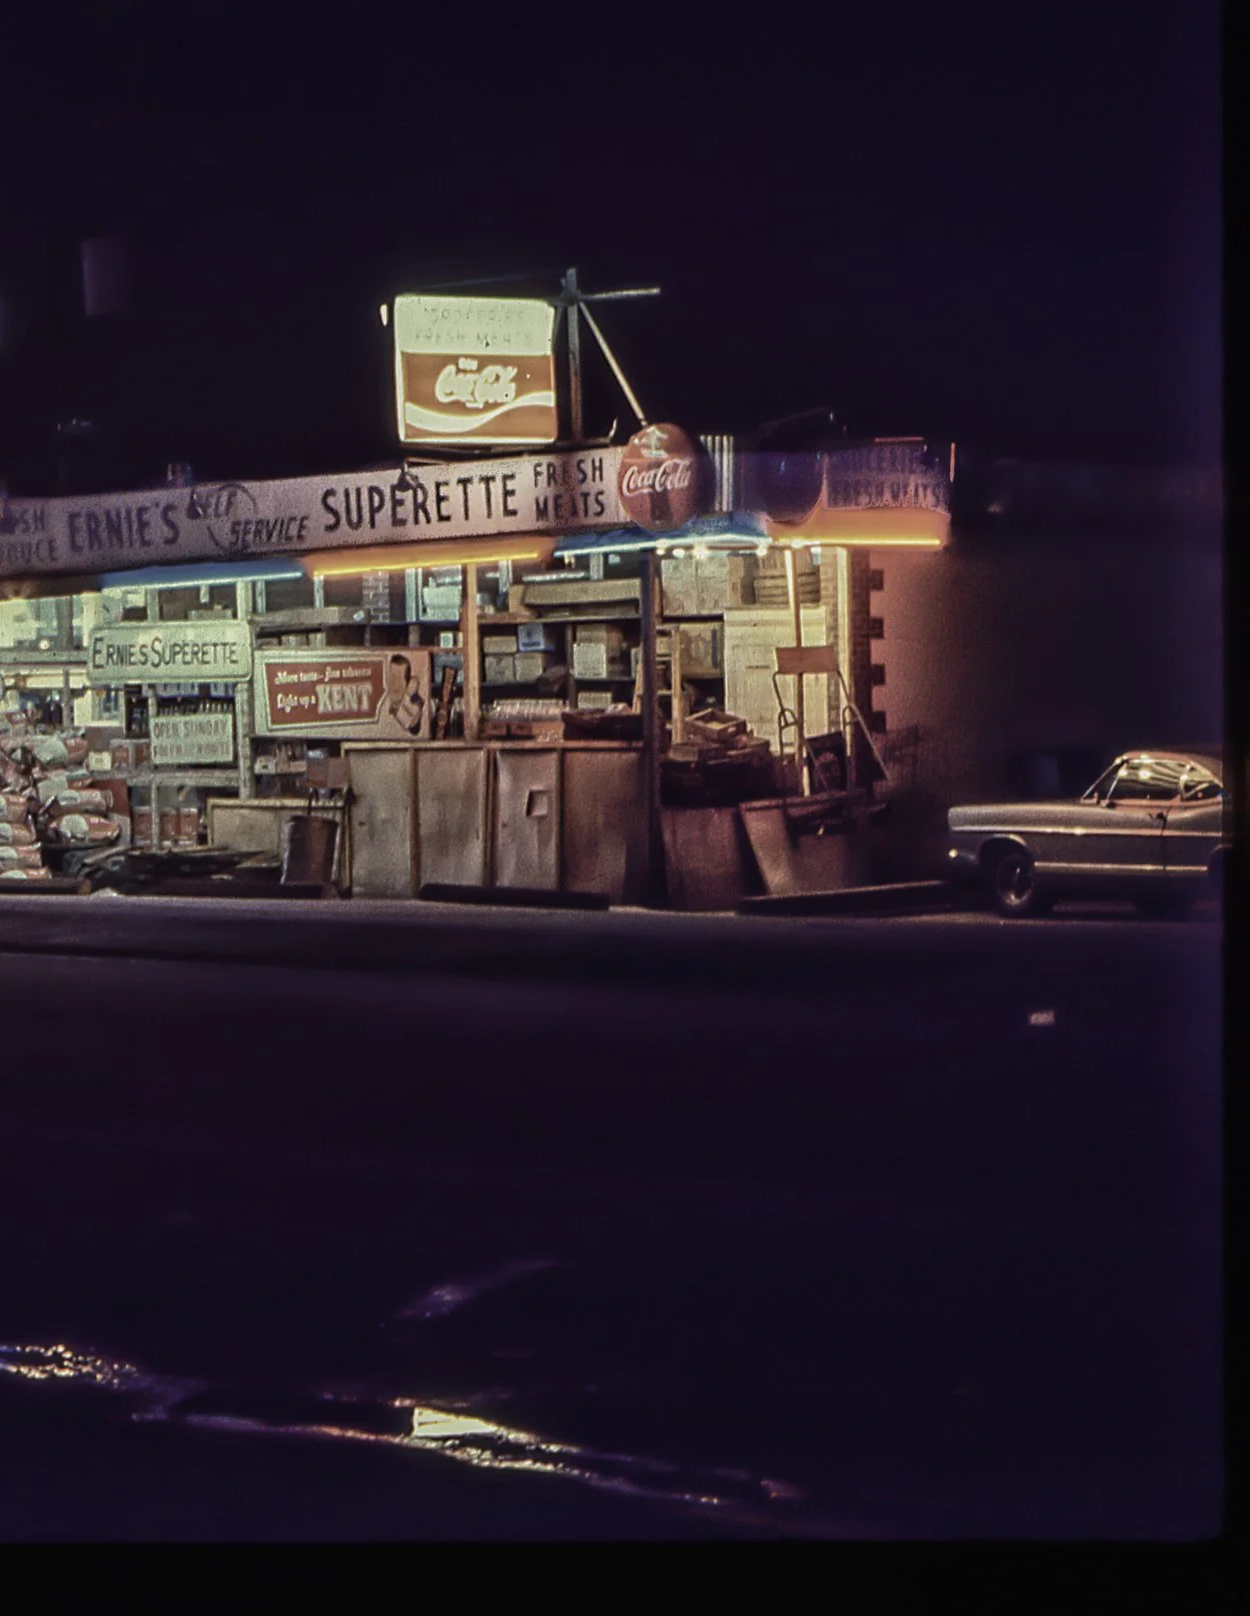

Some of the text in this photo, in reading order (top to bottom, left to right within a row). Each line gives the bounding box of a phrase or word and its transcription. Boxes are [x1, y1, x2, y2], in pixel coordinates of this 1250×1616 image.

[321, 472, 518, 533] SUPERETTE
[67, 503, 180, 553] ERNIE'S
[229, 515, 310, 546] SERVICE
[316, 682, 373, 714] KENT
